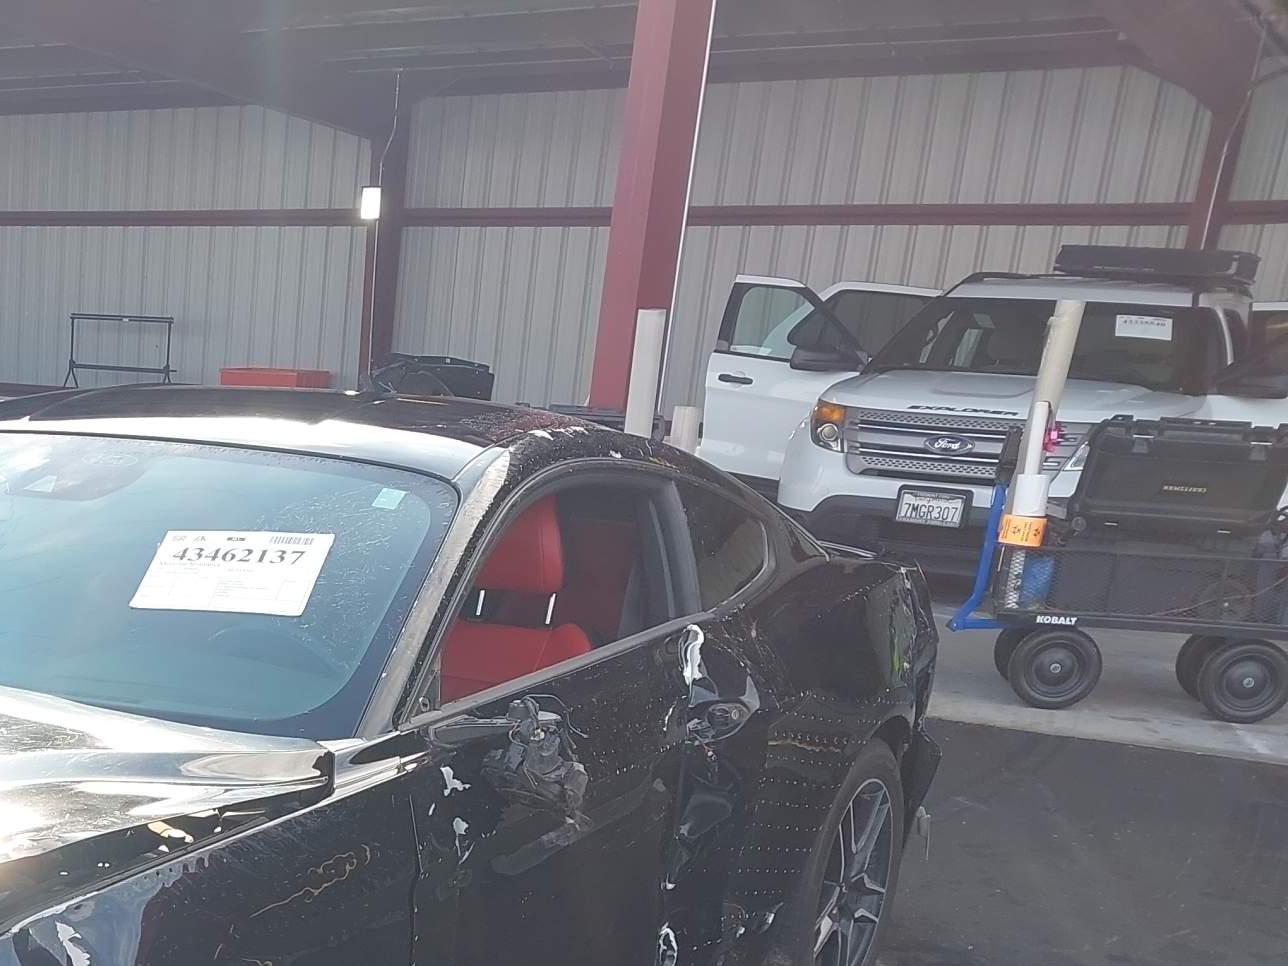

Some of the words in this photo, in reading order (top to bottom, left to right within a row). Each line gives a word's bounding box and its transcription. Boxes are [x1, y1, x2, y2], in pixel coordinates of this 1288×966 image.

[934, 438, 961, 450] Ford
[904, 502, 958, 521] 7MGR307
[173, 547, 305, 565] 43462137
[1036, 615, 1078, 625] KOBALT
